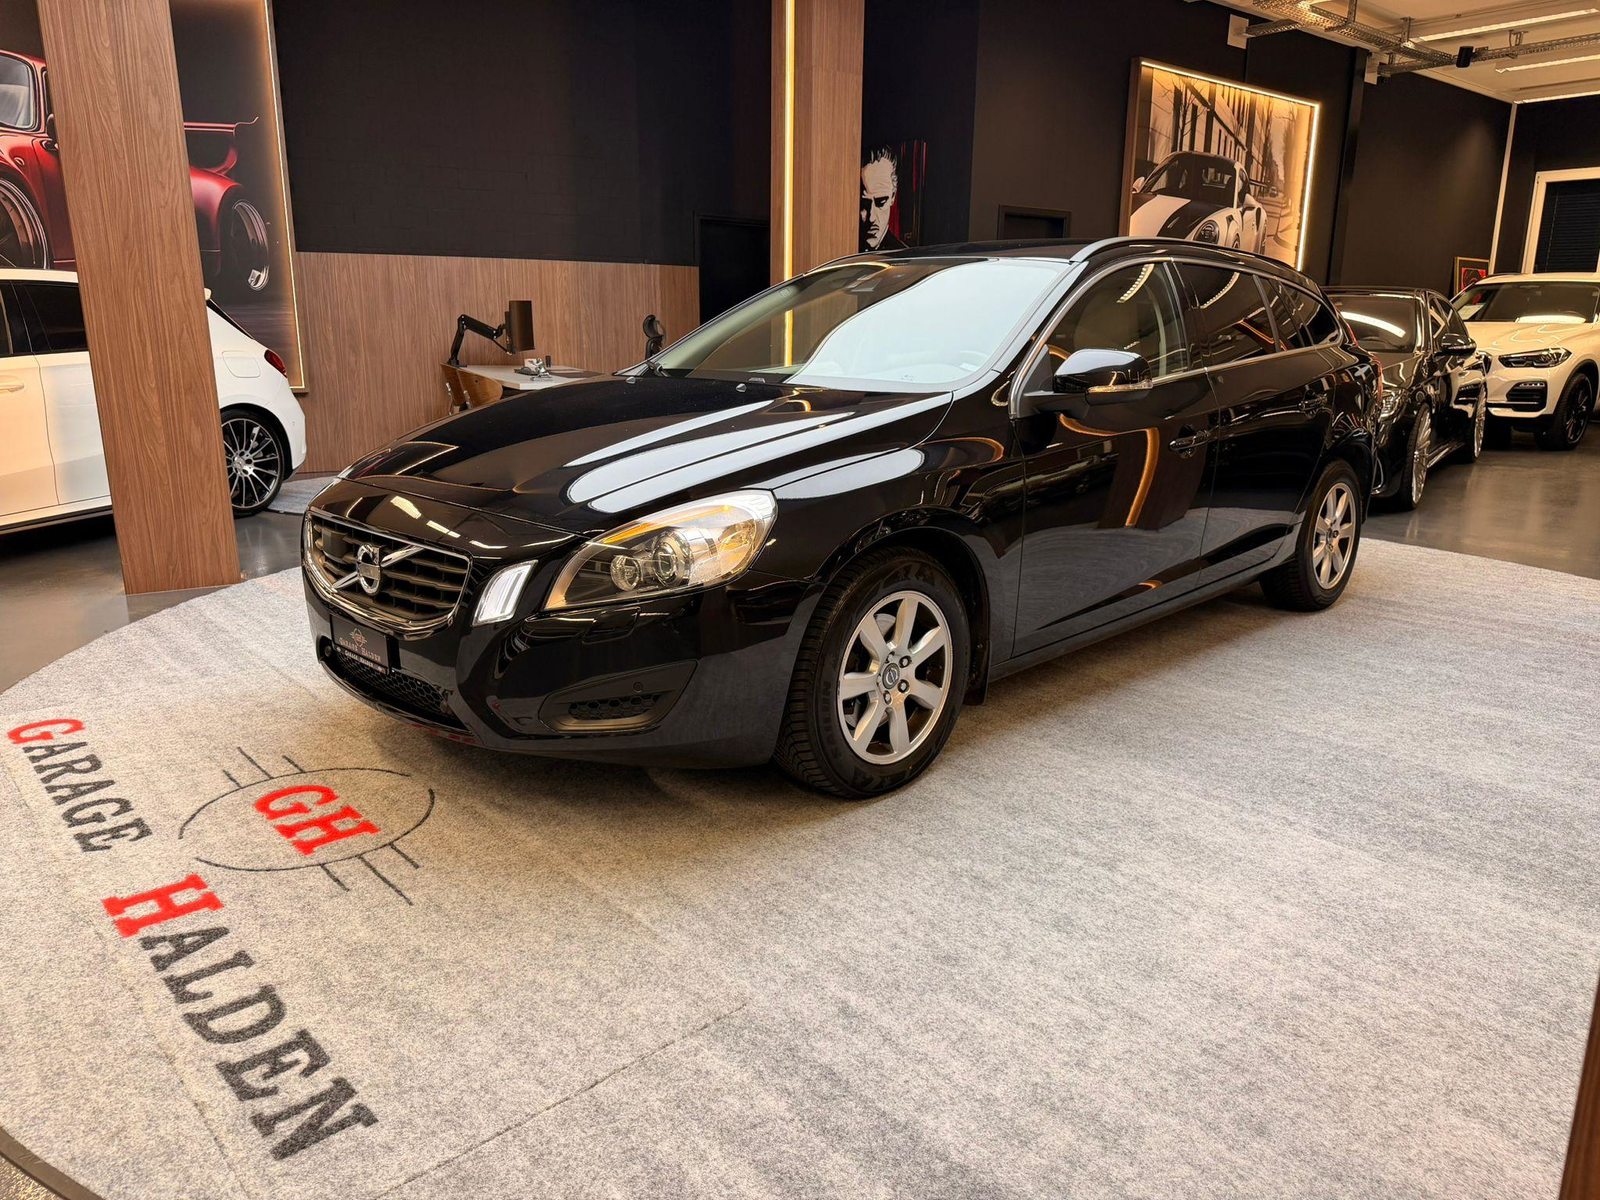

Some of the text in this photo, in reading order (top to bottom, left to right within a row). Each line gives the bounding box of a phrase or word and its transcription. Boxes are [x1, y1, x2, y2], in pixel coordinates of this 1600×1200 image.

[8, 719, 379, 1160] GARAGE HALDEN
[254, 785, 380, 855] GH
